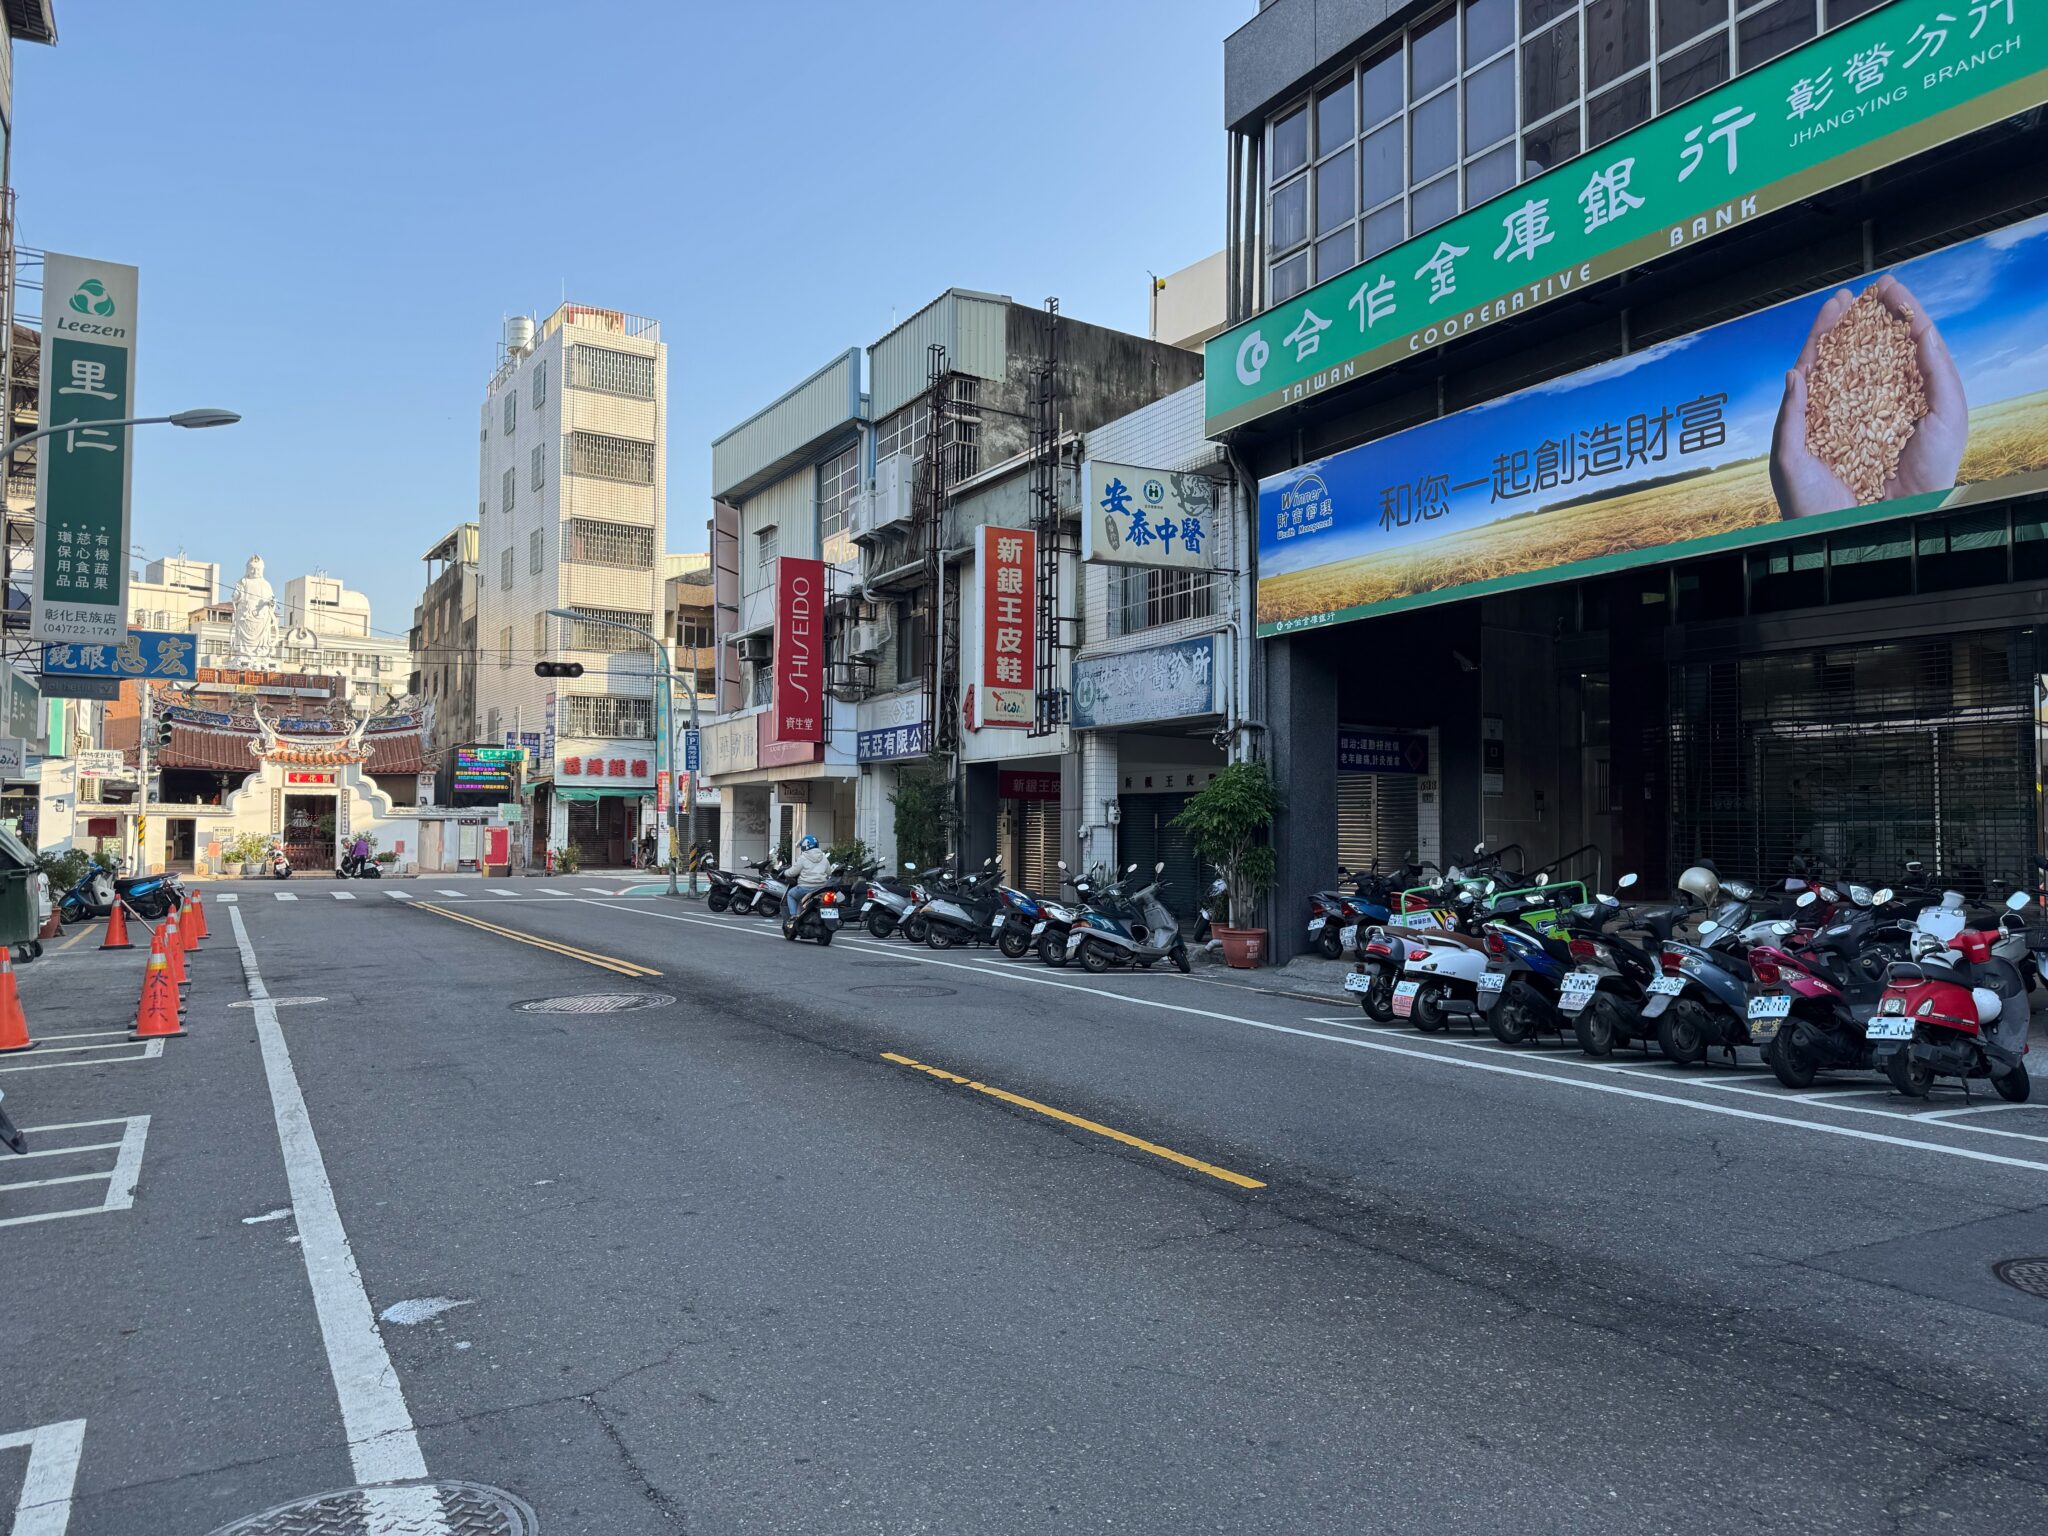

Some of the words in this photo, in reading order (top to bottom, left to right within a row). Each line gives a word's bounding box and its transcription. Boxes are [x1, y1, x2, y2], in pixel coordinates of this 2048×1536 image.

[1786, 0, 2014, 121] 彰營分行
[1788, 86, 1909, 148] JHANGYING
[1923, 34, 2022, 90] BRANCH
[1283, 106, 1757, 362] 合作金庫銀行
[57, 316, 126, 339] Leezen
[1282, 362, 1356, 403] TAIWAN
[1409, 263, 1592, 351] COOPERATIVE
[1670, 194, 1757, 247] BANK
[58, 359, 118, 454] 里仁
[1378, 391, 1728, 533] 和您一起創造財富
[1100, 477, 1206, 556] 安泰中醫
[1276, 498, 1334, 530] 財富管理
[1281, 487, 1323, 511] Winner
[1276, 527, 1296, 541] Wealth
[1297, 516, 1334, 536] Management
[56, 530, 73, 588] 環保用品
[75, 532, 91, 589] 慈心食品
[94, 533, 110, 590] 有機蔬果
[43, 622, 117, 637] (04)722-1747
[44, 607, 117, 625] 彰化民族店
[996, 537, 1023, 684] 新銀王皮鞋
[788, 576, 810, 704] SHISEIDO
[785, 717, 814, 731] 資生堂
